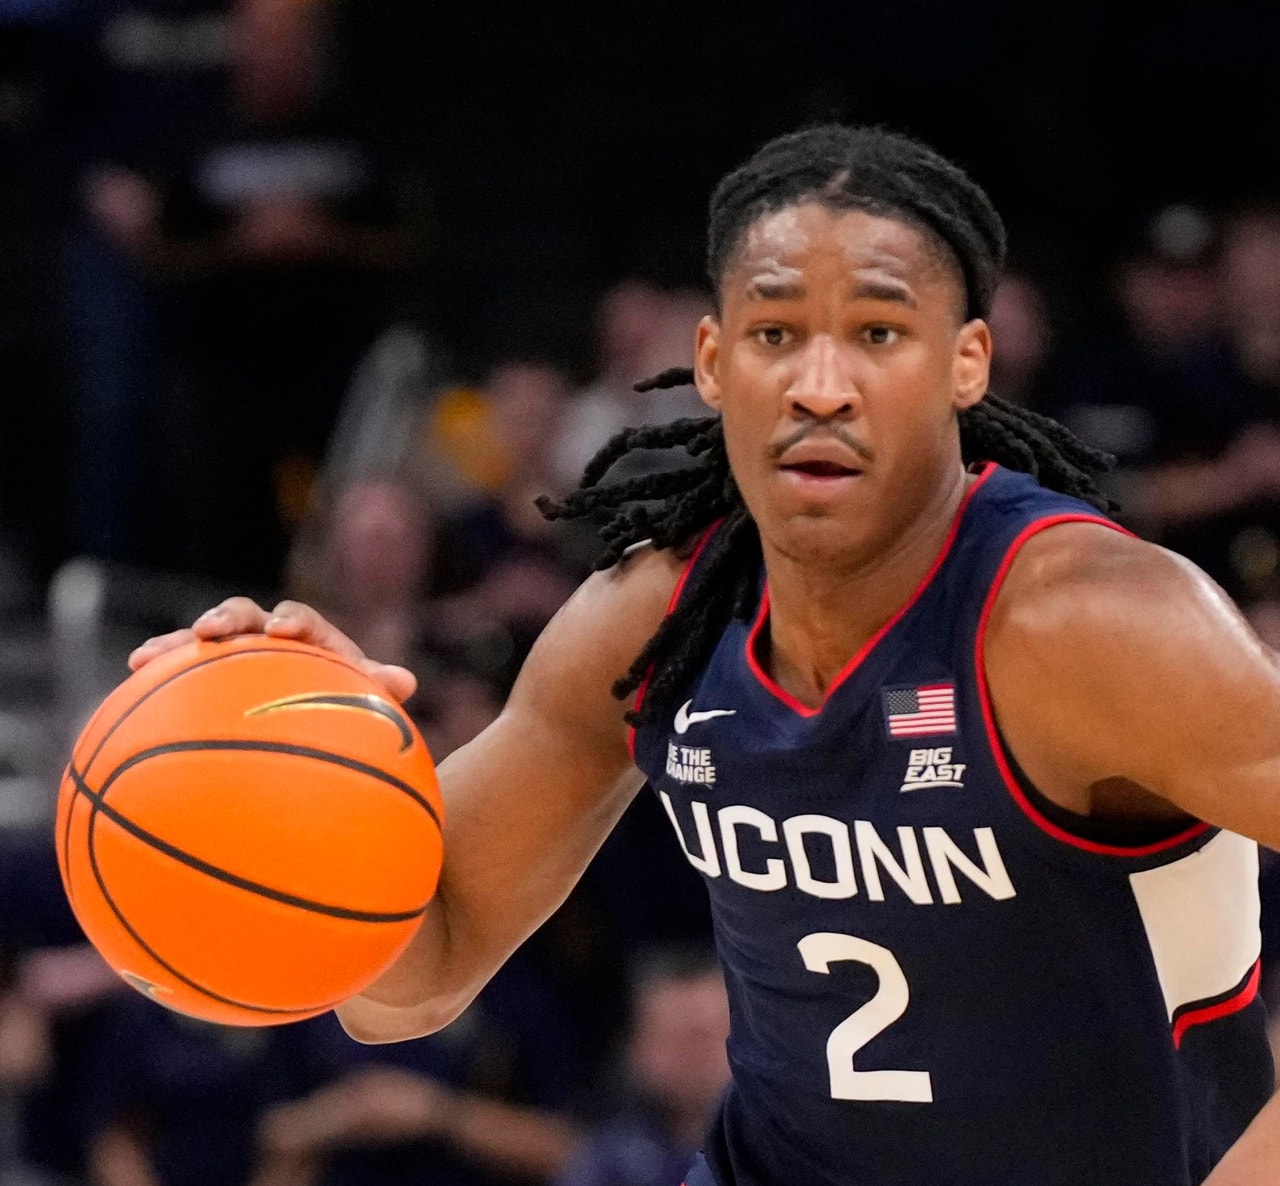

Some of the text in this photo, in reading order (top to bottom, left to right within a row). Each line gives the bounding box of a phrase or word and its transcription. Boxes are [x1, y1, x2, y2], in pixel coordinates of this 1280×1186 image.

[680, 747, 711, 767] THE
[908, 747, 953, 766] BIG
[904, 764, 966, 782] EAST
[660, 790, 1016, 905] UCONN
[797, 931, 933, 1103] 2
